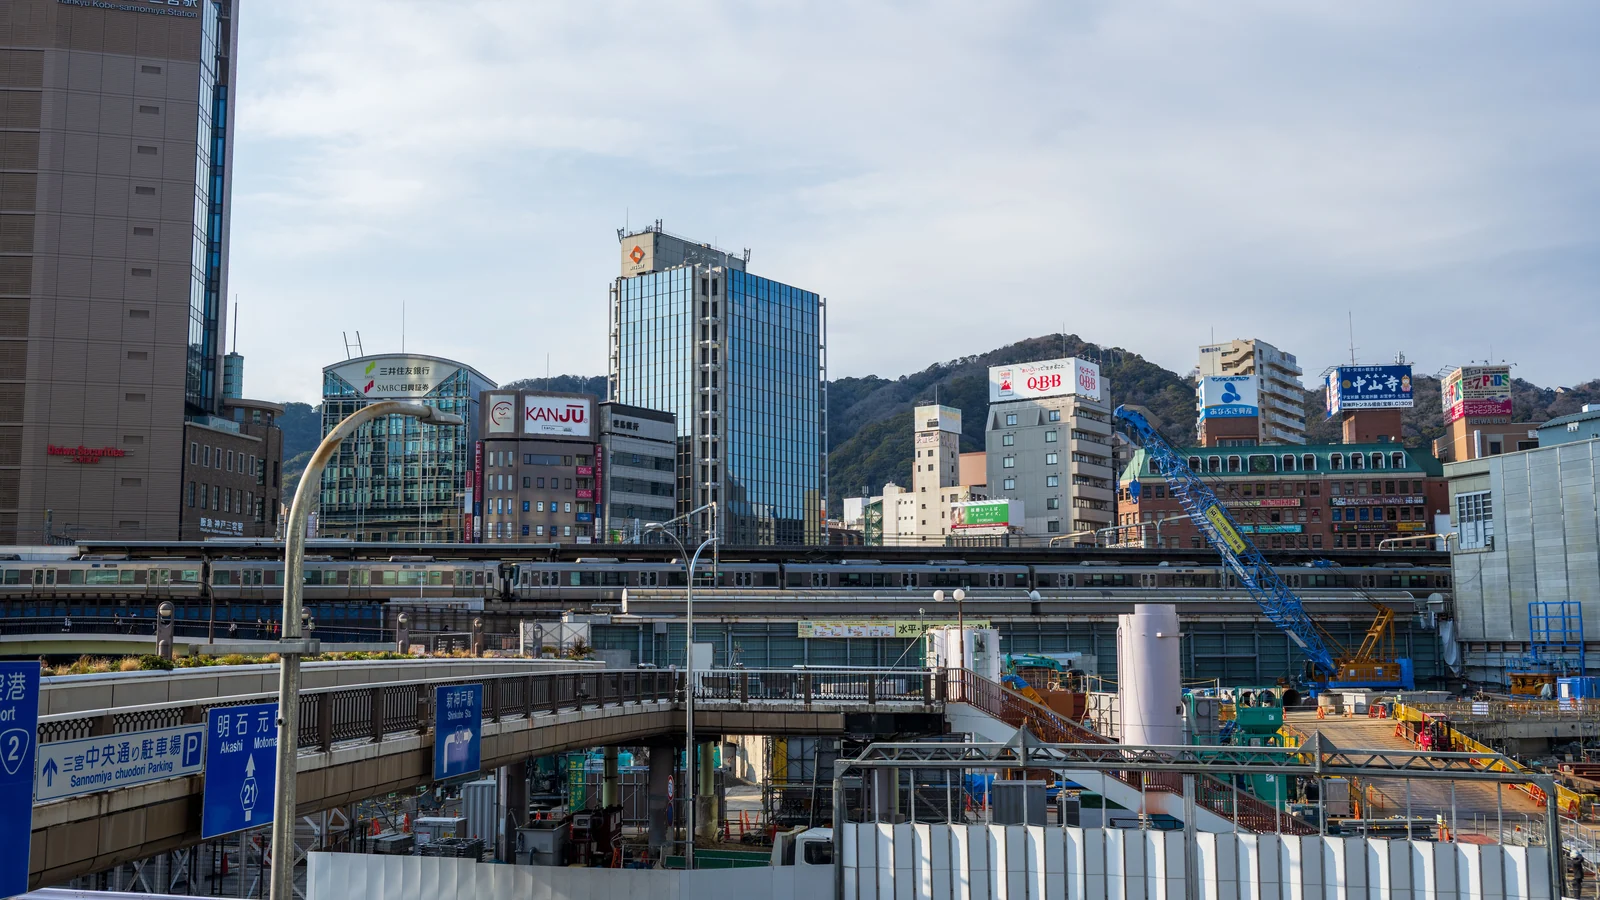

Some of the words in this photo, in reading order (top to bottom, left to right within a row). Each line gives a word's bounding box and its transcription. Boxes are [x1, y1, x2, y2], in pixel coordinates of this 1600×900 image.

[92, 0, 166, 16] Kobe-sannomiya
[167, 7, 198, 18] Station
[380, 366, 430, 376] 三井住友銀行
[377, 384, 429, 392] SMBC日興証券
[1352, 375, 1400, 394] 中山寺
[47, 444, 76, 455] Daiwa
[77, 446, 125, 457] Securities
[0, 672, 26, 701] 港
[446, 690, 474, 709] 新神戸駅
[217, 713, 249, 738] 明石
[257, 710, 279, 733] 元
[8, 735, 19, 761] 2
[63, 735, 182, 773] 三宮中央通り駐車場
[220, 739, 243, 754] Akashi
[70, 771, 112, 788] Sannomiya
[115, 764, 146, 779] chuodori
[147, 759, 174, 774] Parking
[244, 783, 255, 805] 21
